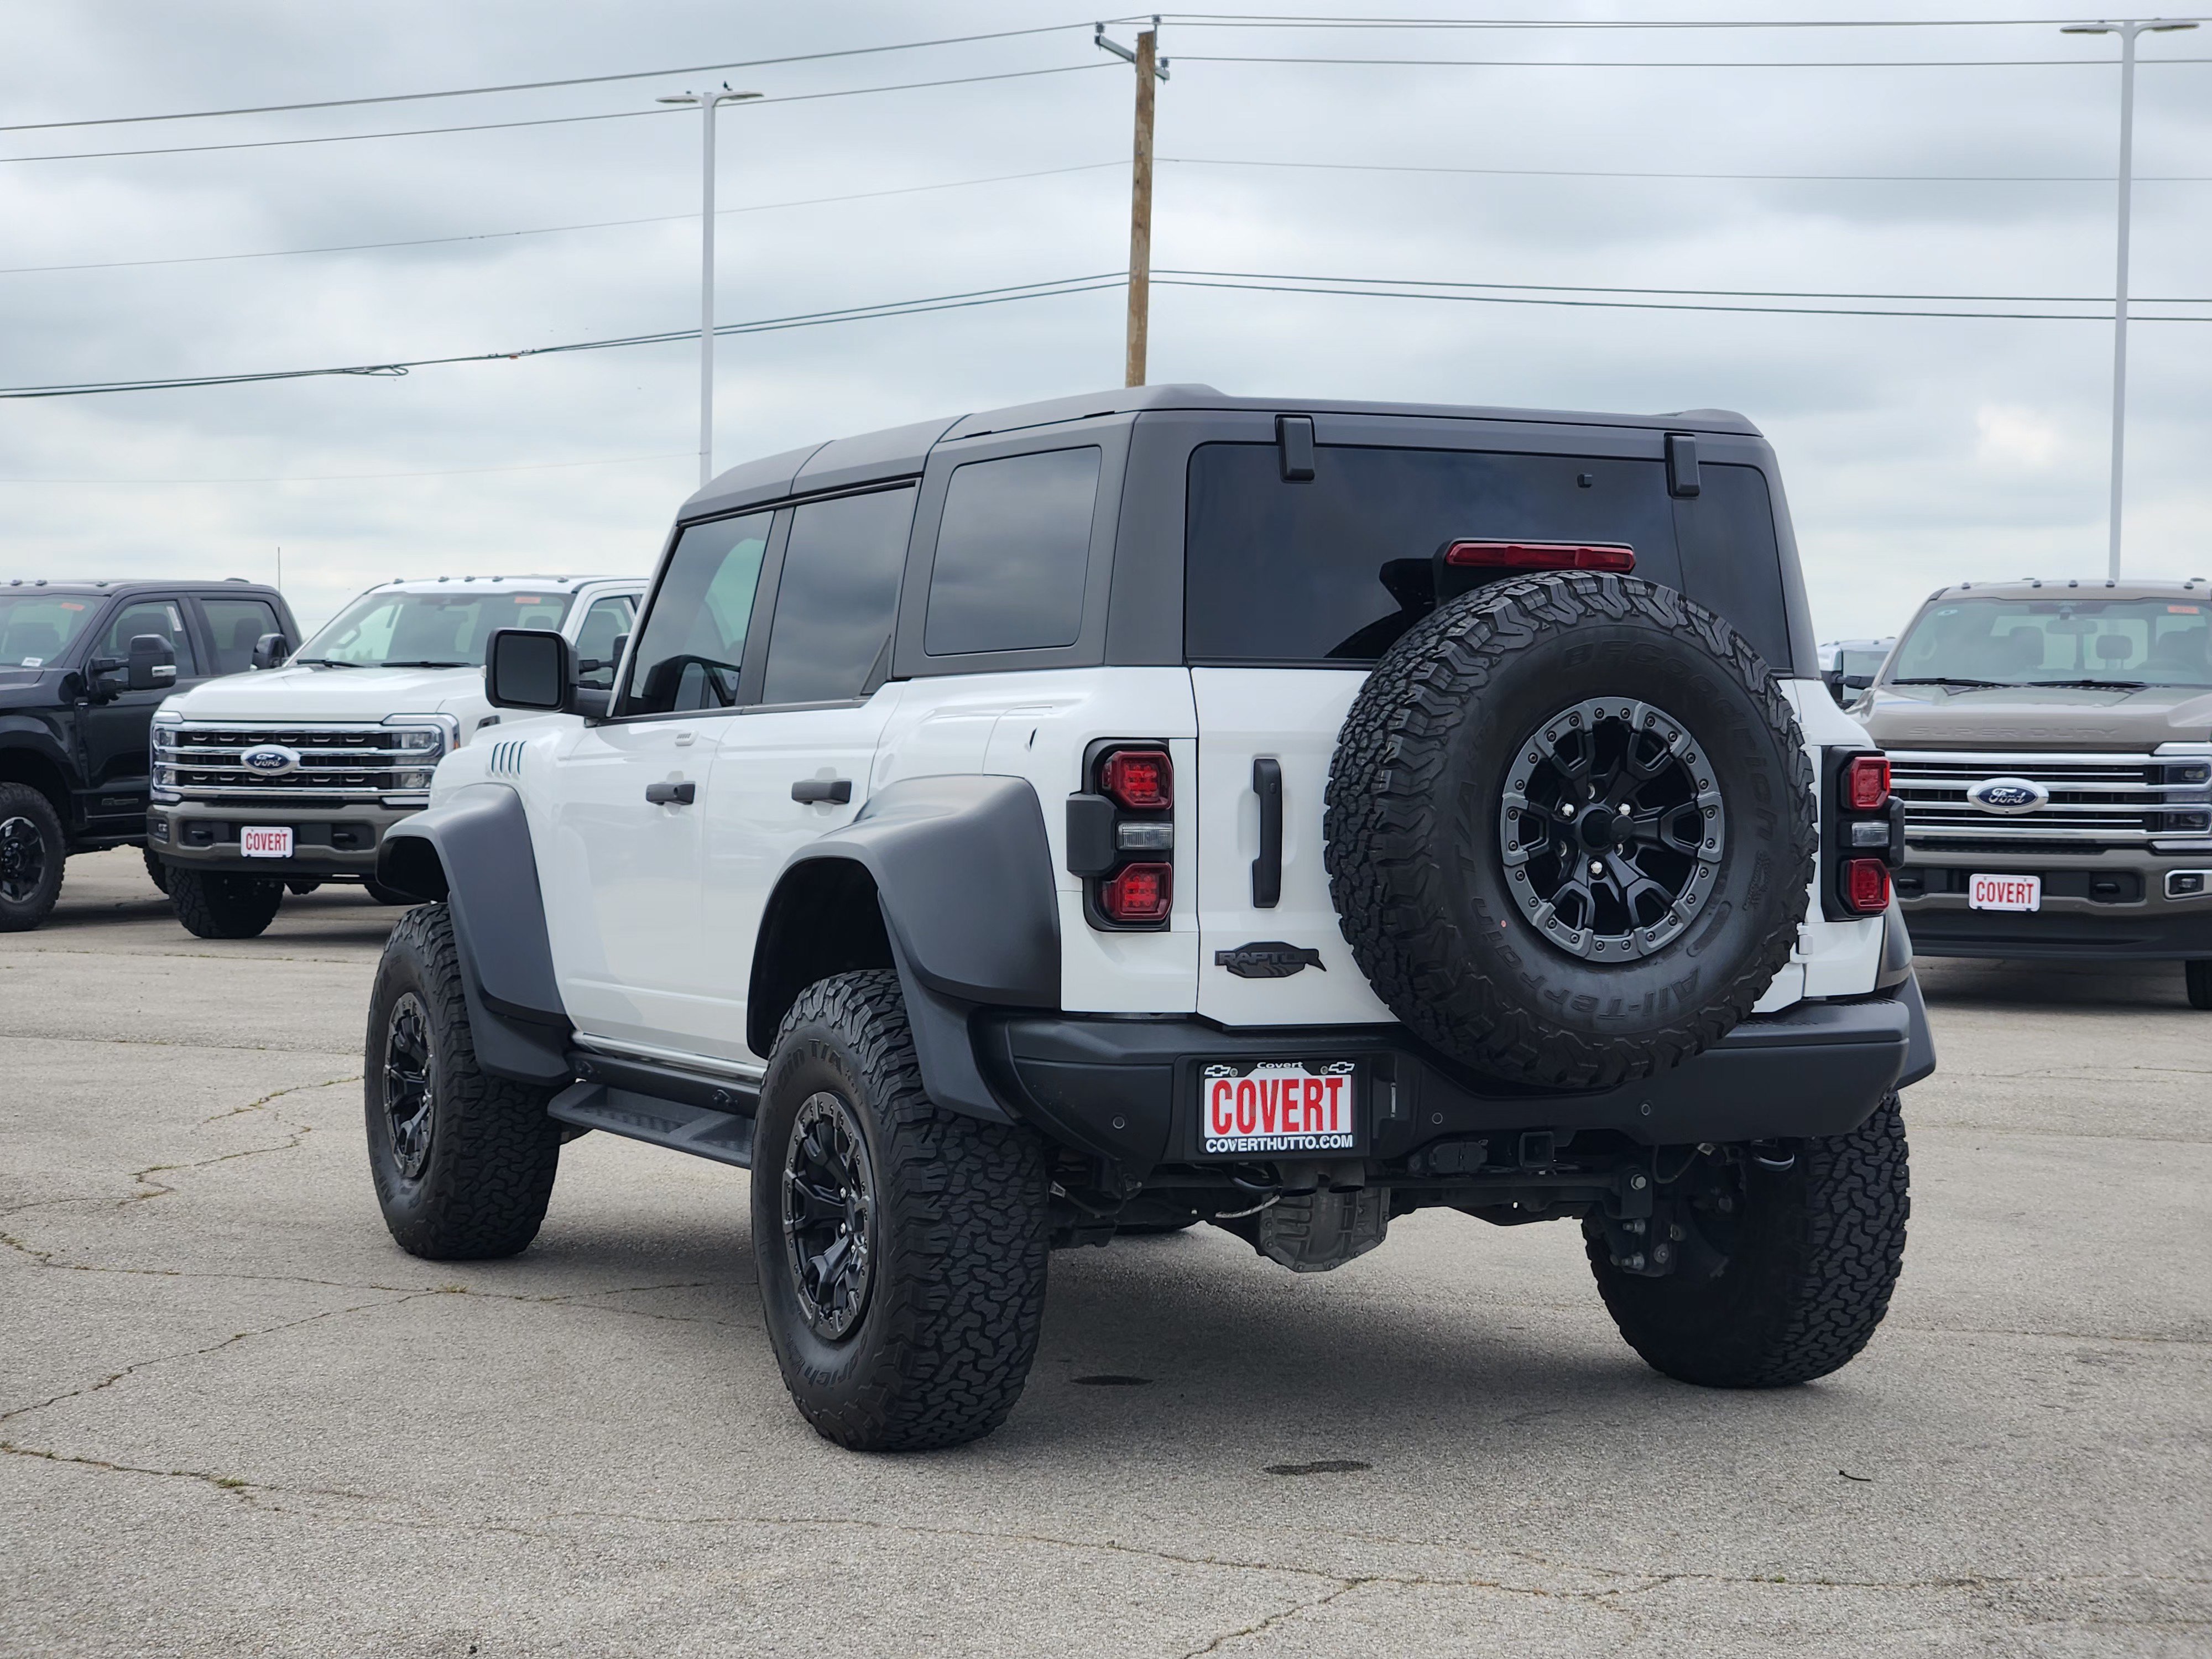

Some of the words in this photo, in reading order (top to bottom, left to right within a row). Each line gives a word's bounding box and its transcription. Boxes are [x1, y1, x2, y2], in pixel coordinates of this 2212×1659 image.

[253, 753, 283, 768] Ford
[1988, 787, 2025, 806] Ford
[246, 832, 288, 851] COVERT
[1975, 880, 2036, 905] COVERT
[1256, 1061, 1304, 1070] Covert
[1212, 1077, 1343, 1135] COVERT
[1205, 1134, 1354, 1154] COVERTHUTTO.COM
